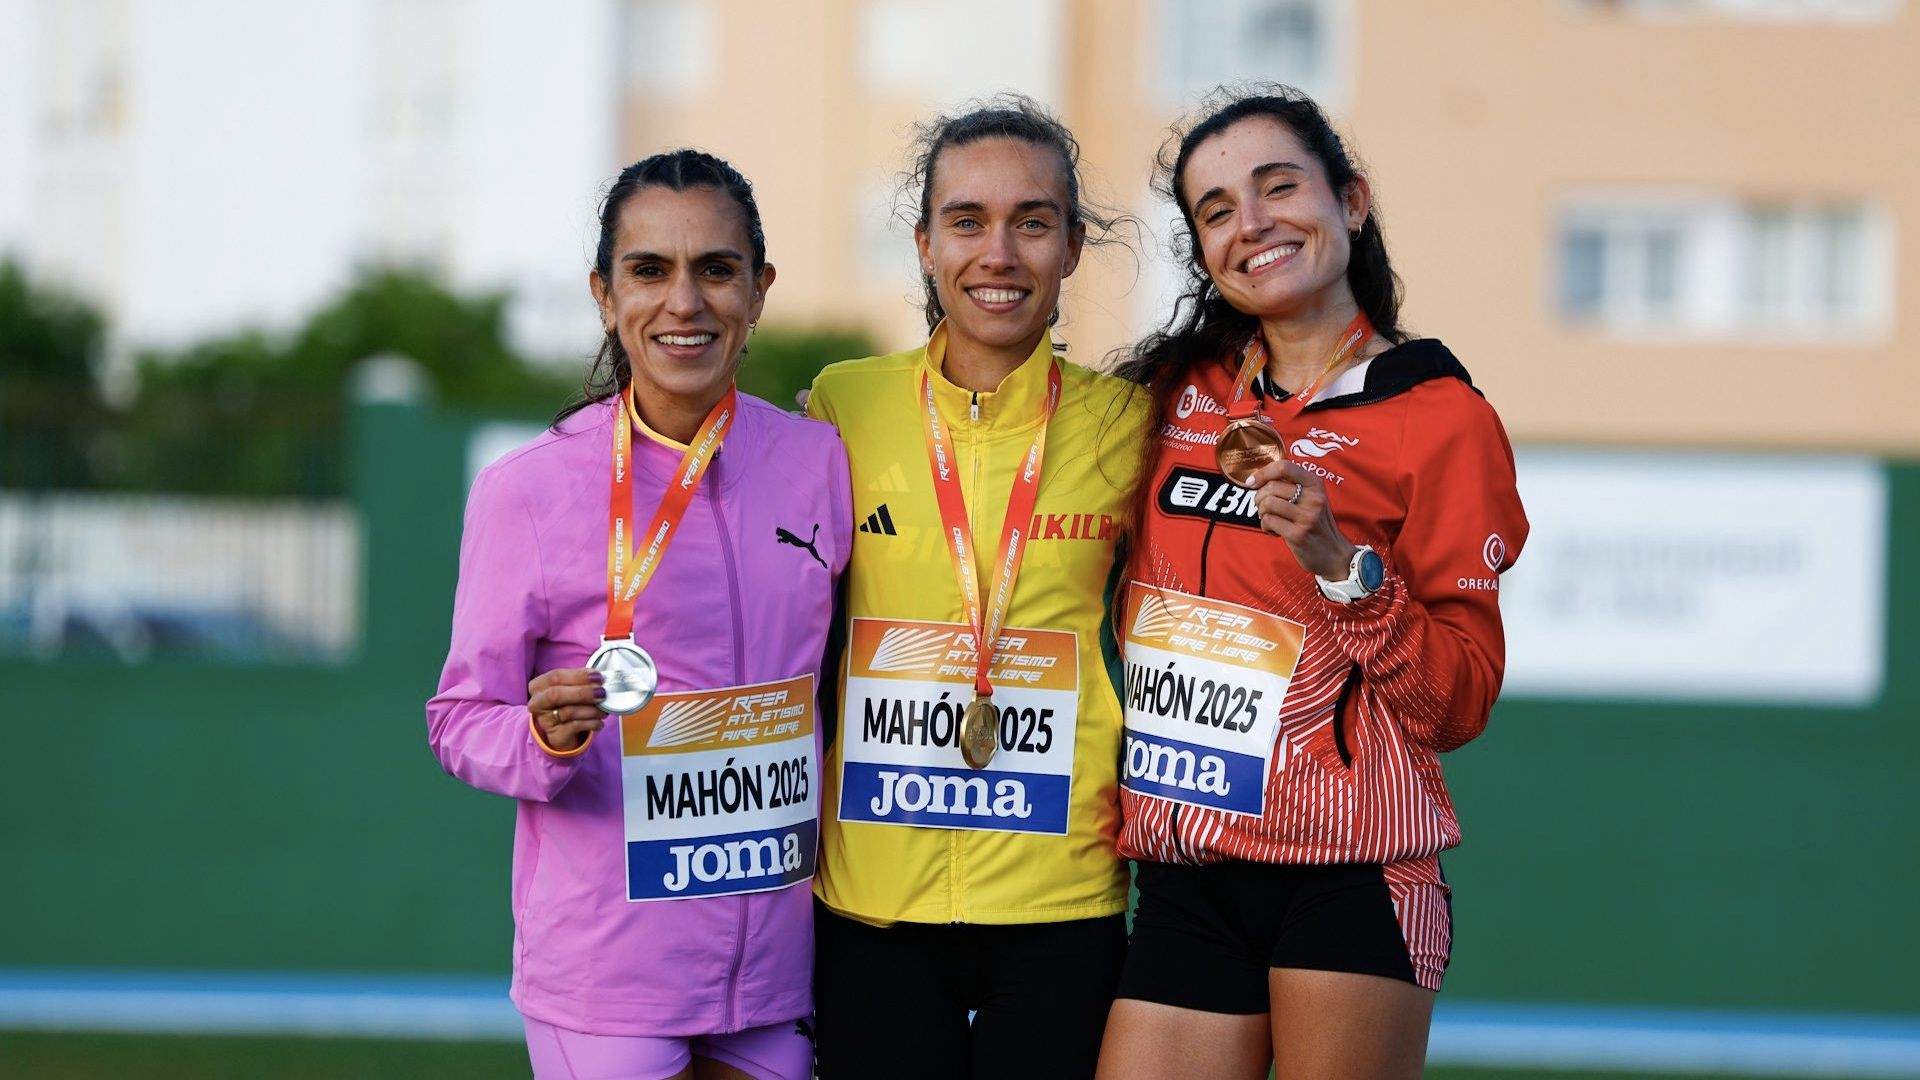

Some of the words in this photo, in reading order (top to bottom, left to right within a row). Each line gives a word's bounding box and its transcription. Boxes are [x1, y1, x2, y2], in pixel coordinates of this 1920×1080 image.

[1177, 387, 1227, 418] Bilba
[1161, 423, 1221, 446] Bizkaial
[1187, 606, 1254, 629] RFEA
[952, 632, 1029, 653] REA
[1167, 634, 1208, 653] AIRE
[1210, 645, 1262, 664] LIBRE
[1178, 621, 1278, 652] ATLETISMO
[987, 667, 1044, 684] LIBRE
[731, 689, 789, 714] RFEA
[1126, 661, 1196, 722] MAHÓN
[1194, 679, 1264, 734] 2025
[725, 703, 804, 728] ATLETISMO
[720, 727, 759, 742] AIRE
[763, 720, 800, 738] LIBRE
[998, 705, 1055, 755] 025
[646, 757, 764, 821] MAHÓN
[767, 755, 809, 809] 2025
